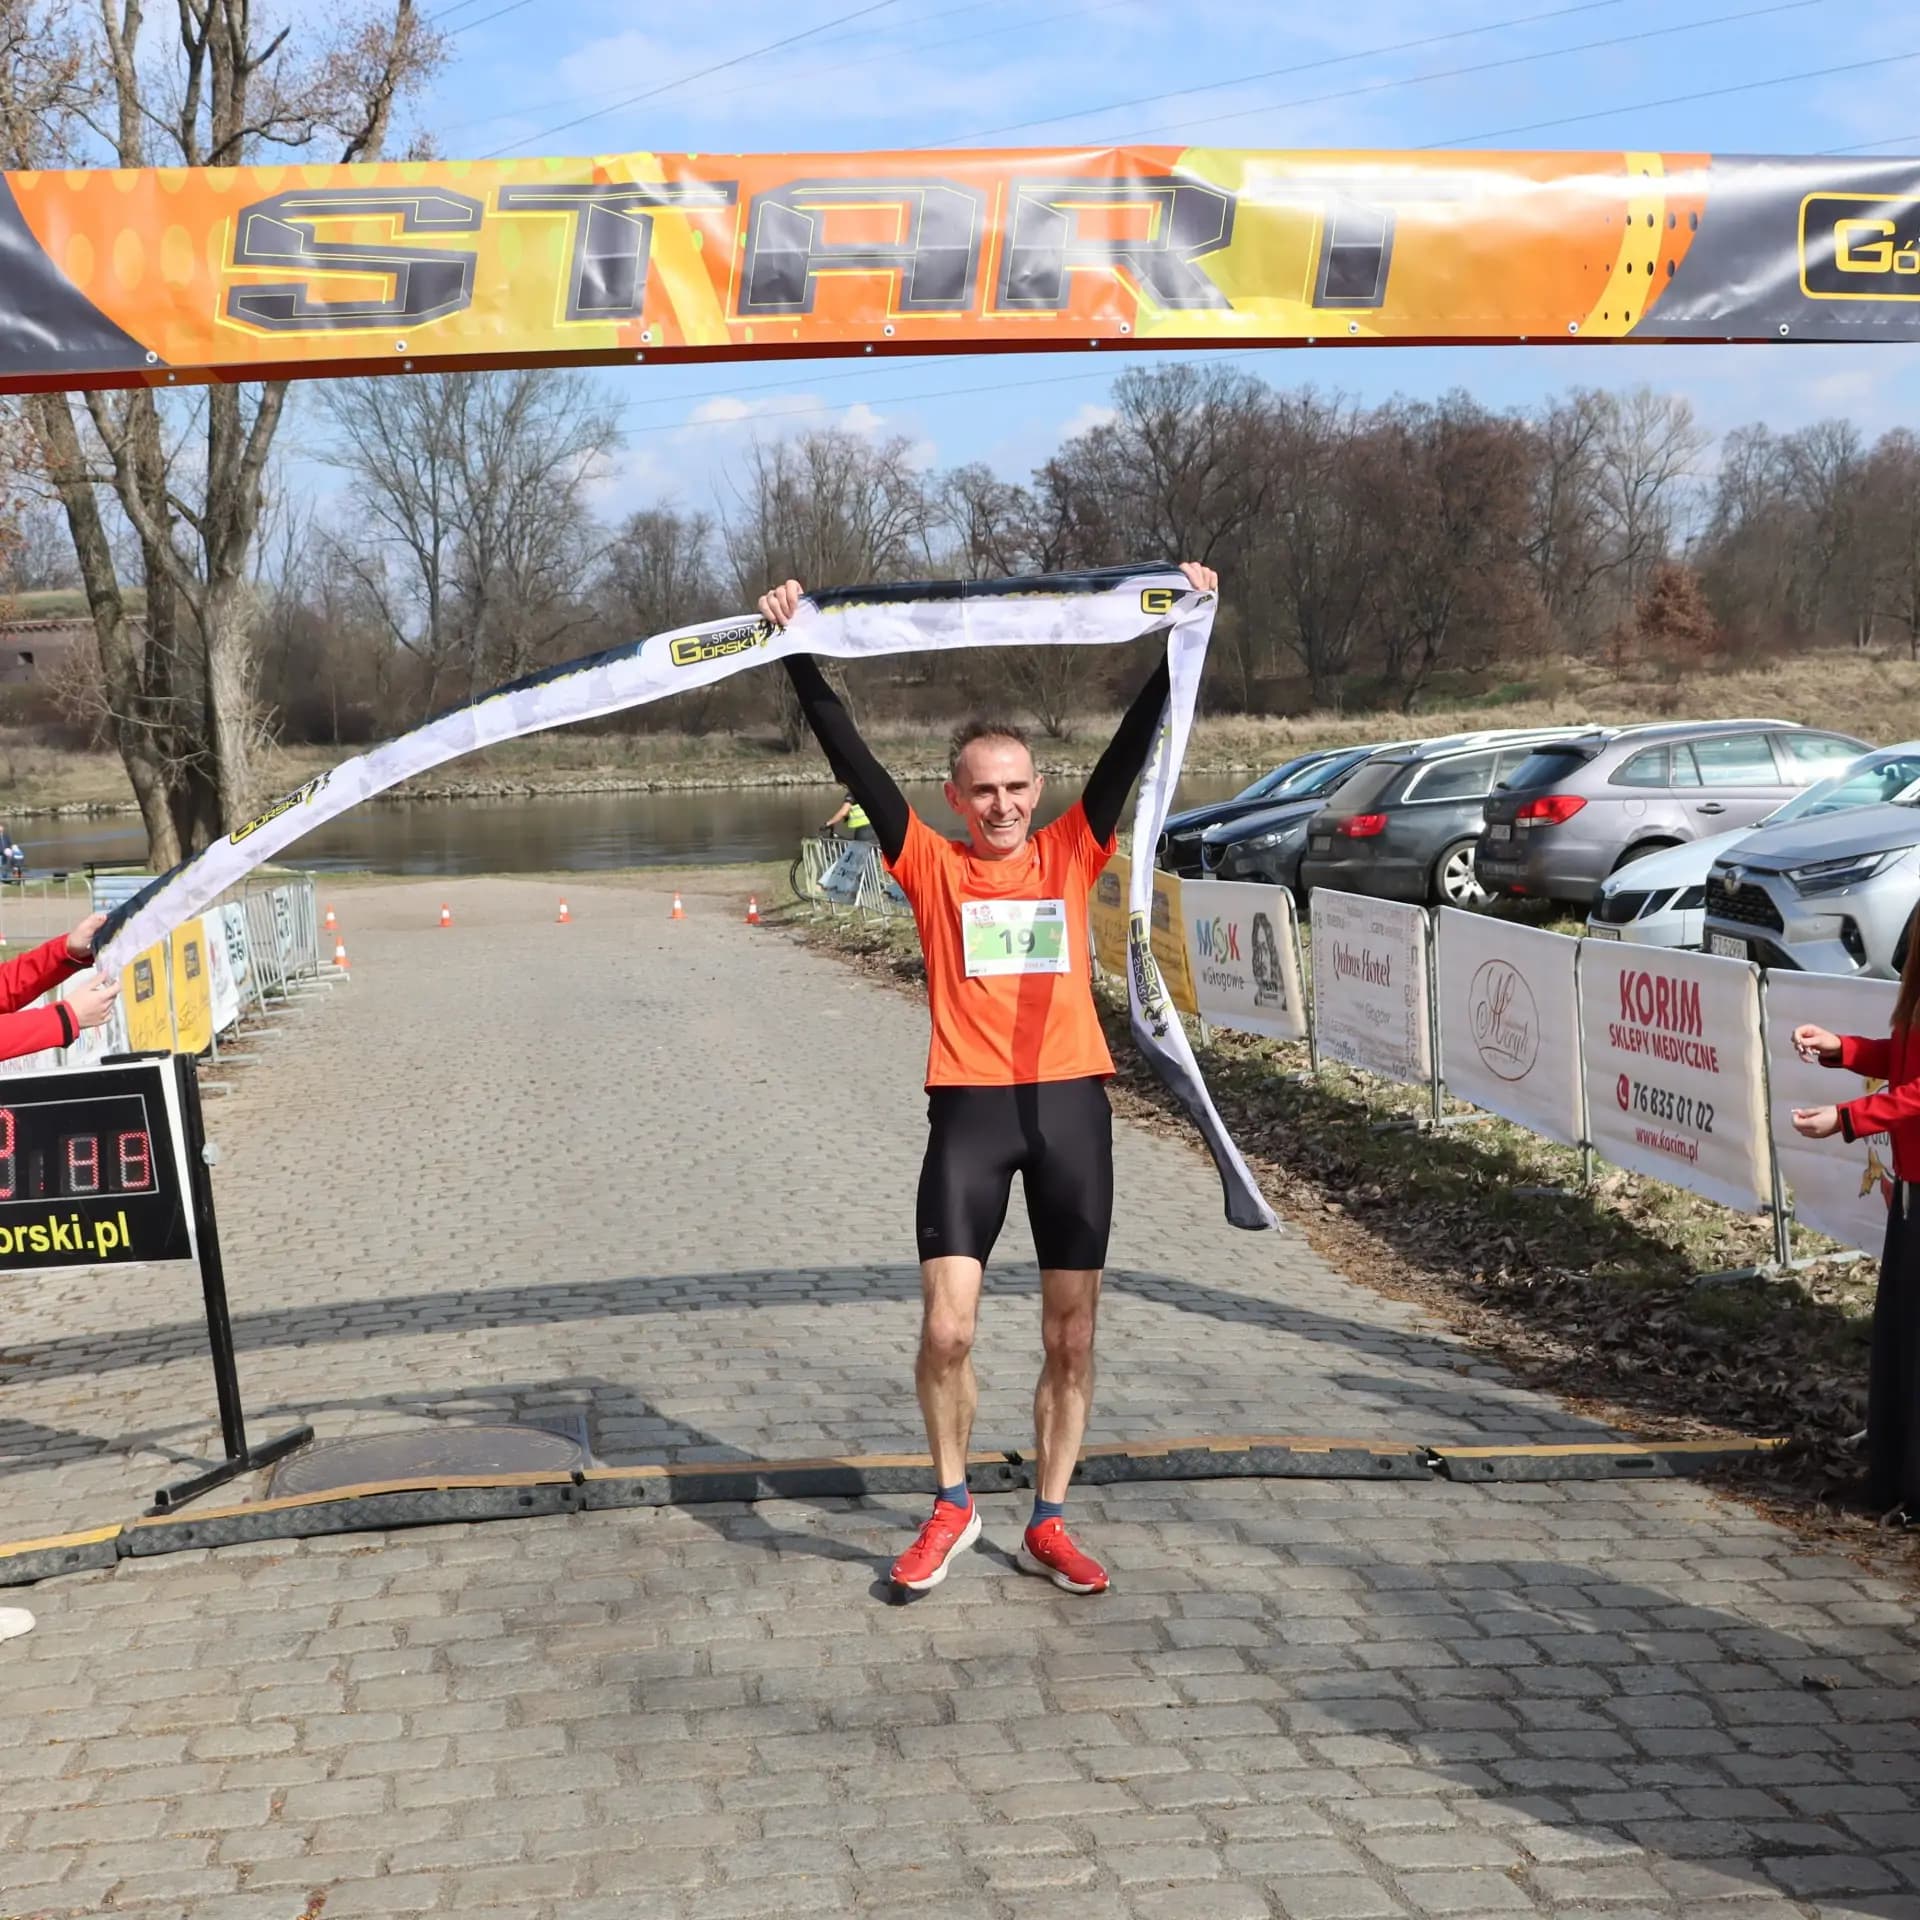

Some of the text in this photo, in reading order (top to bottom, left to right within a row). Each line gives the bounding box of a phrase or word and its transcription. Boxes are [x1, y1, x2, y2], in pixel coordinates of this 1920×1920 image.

[216, 172, 1472, 338] START
[712, 625, 752, 644] SPORT
[999, 929, 1035, 954] 19
[1333, 940, 1391, 987] Qubus Hotel
[1619, 969, 1702, 1037] KORIM
[1609, 1023, 1720, 1074] SKLEPY MEDYCZNE
[1633, 1082, 1715, 1133] 76 835 01 02
[1635, 1126, 1698, 1164] www.korim.pl
